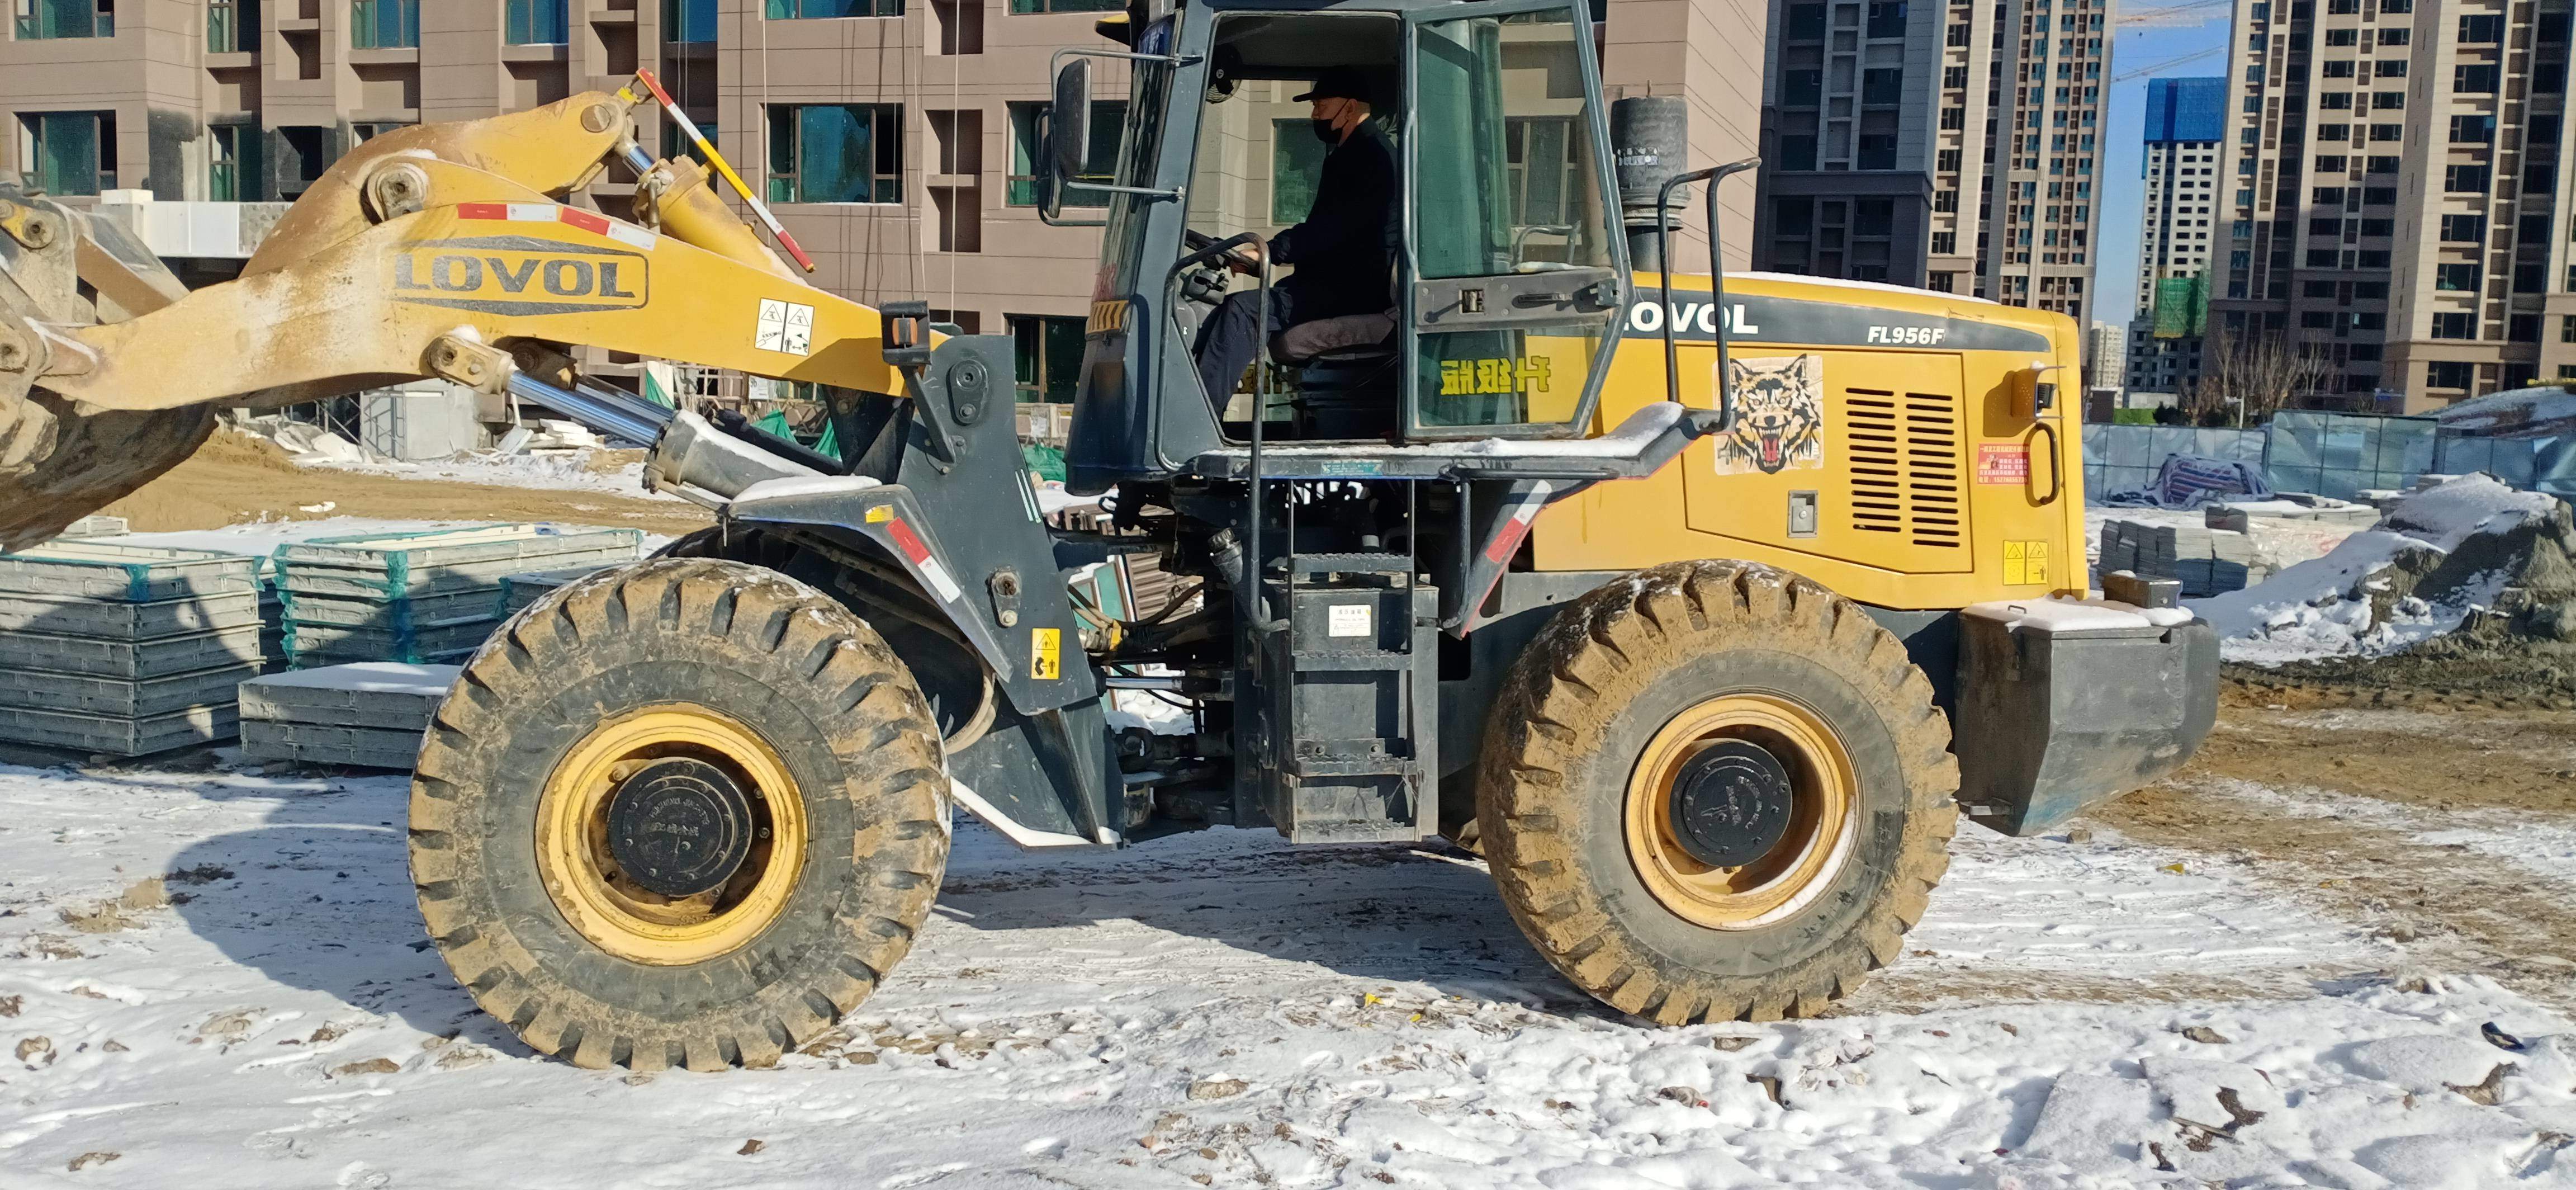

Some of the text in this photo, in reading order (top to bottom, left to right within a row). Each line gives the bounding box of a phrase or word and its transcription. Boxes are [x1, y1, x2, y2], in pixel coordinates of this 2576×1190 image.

[393, 253, 636, 298] LOVOL
[1623, 301, 1759, 334] OVOL
[1867, 326, 1945, 345] FL956F
